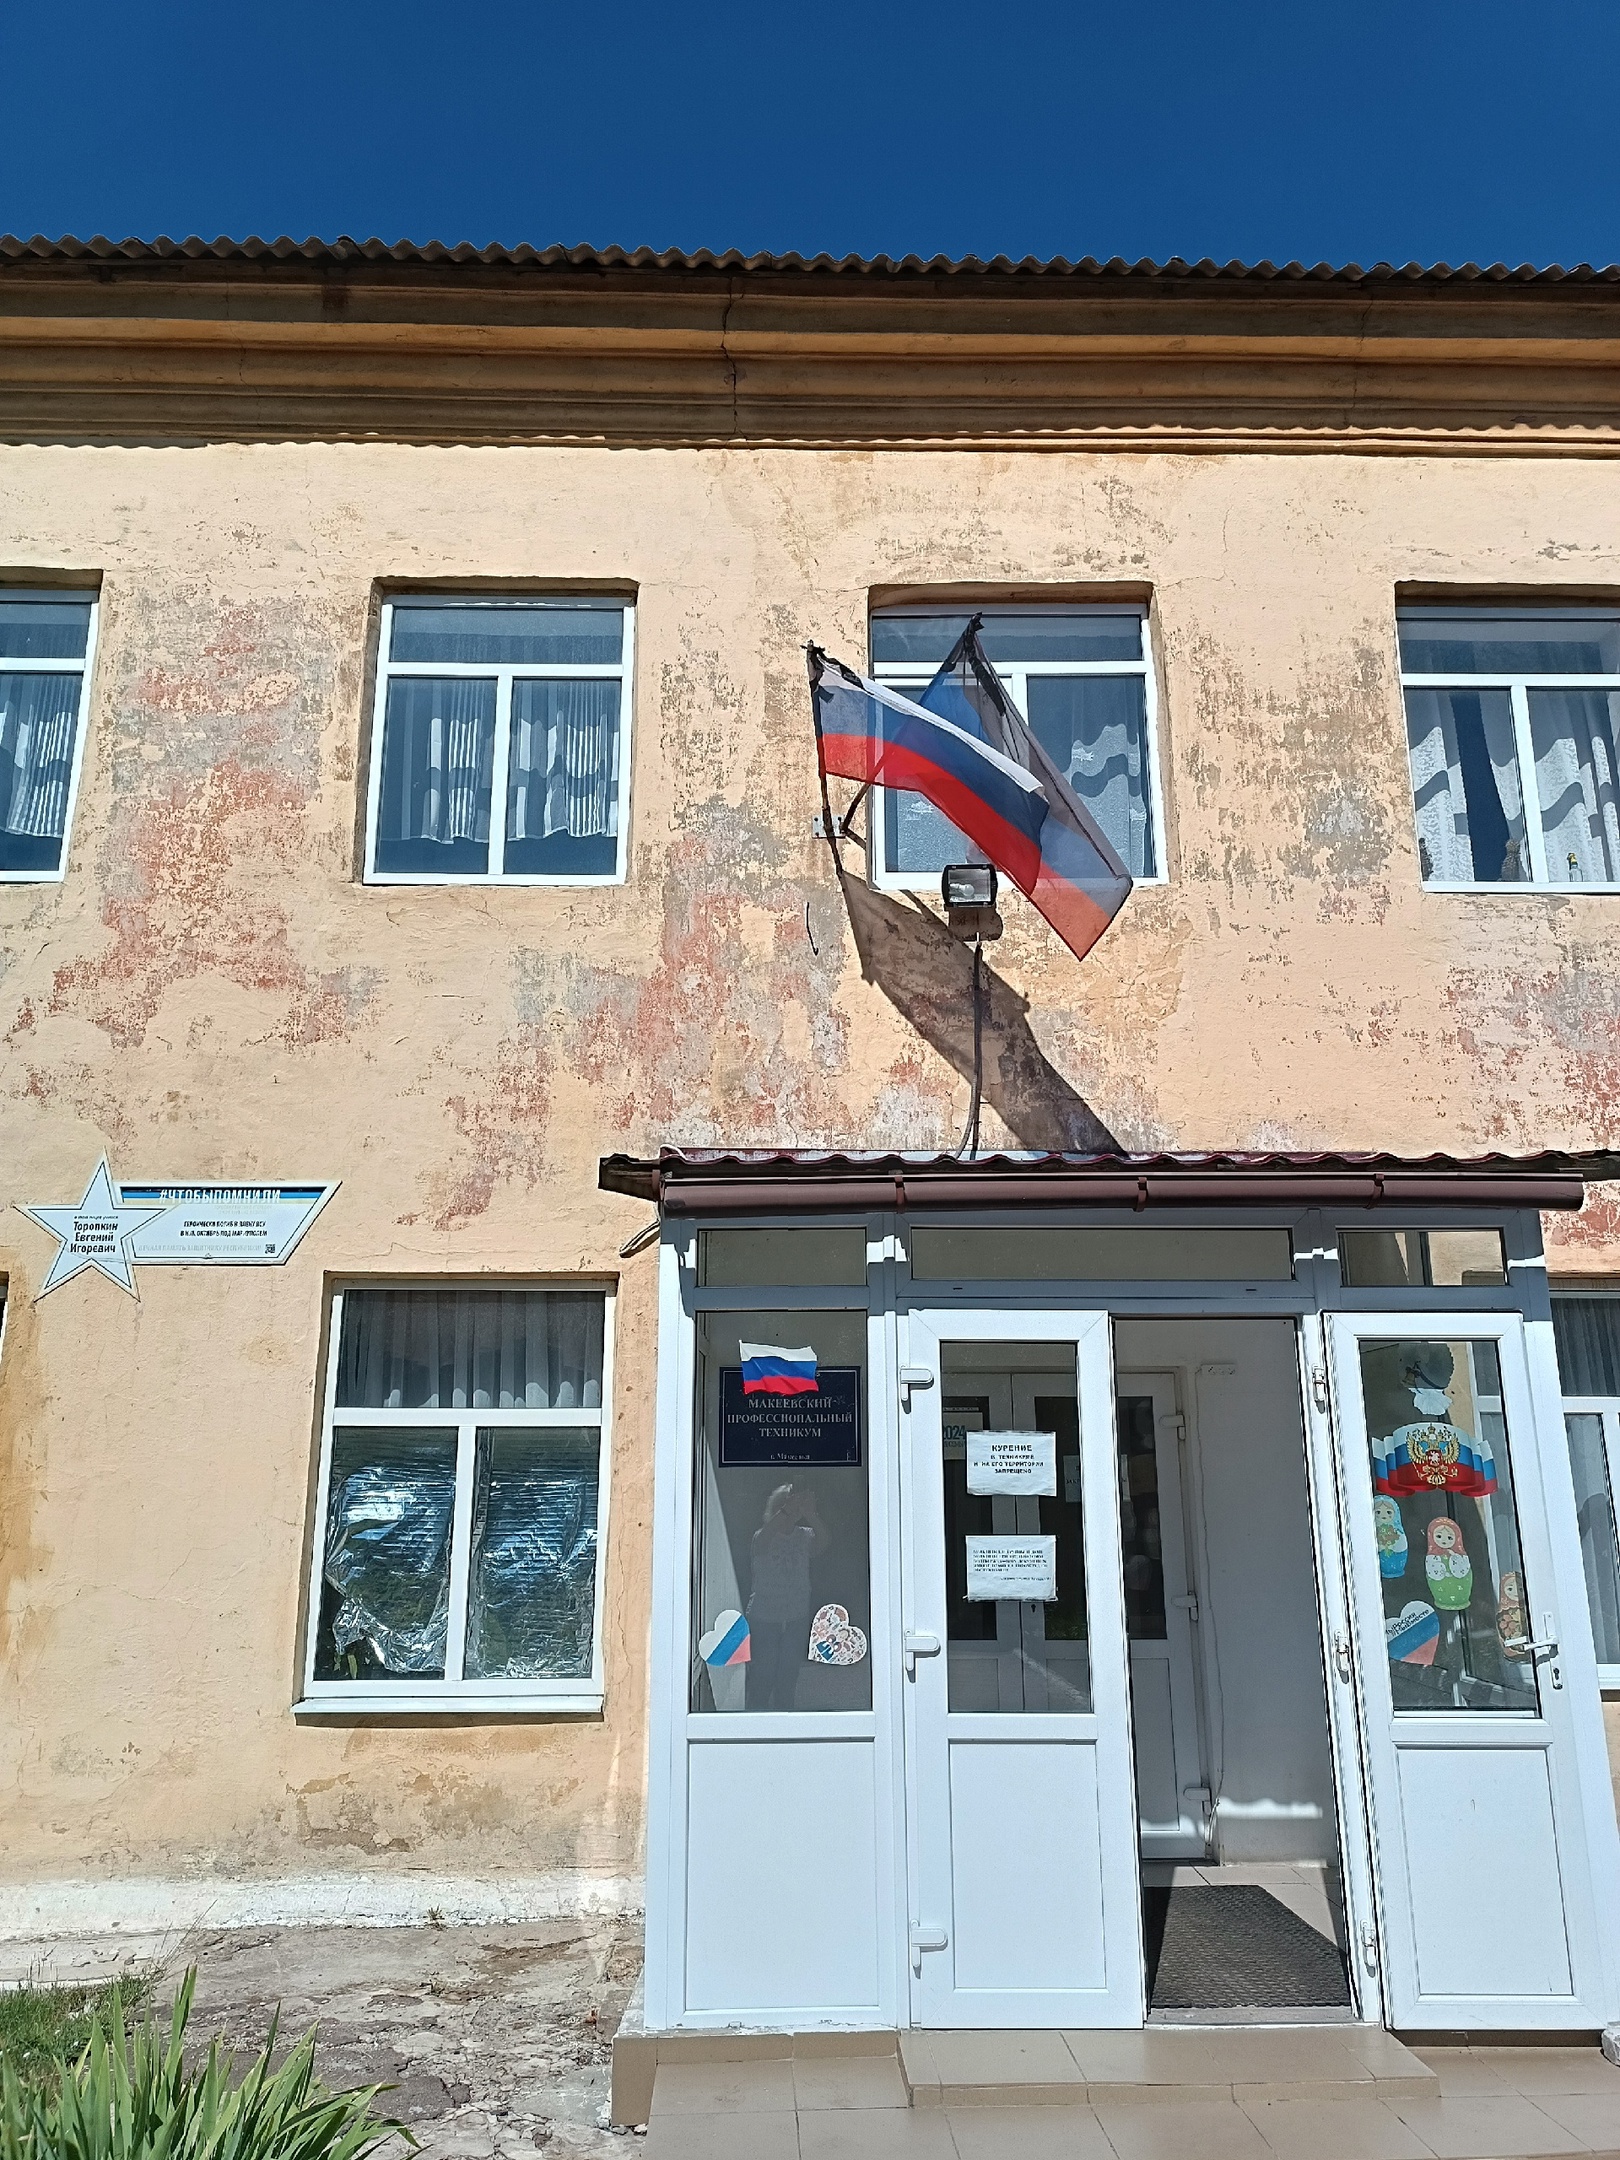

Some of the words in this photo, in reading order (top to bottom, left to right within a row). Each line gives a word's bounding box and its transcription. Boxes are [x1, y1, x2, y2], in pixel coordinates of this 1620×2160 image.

[159, 1189, 281, 1204] #ЧТОБЫПОМНИЛИ
[73, 1221, 118, 1232] Торопкин
[75, 1231, 114, 1242] Евгений
[220, 1230, 231, 1238] ПОД
[70, 1243, 116, 1255] Игоревич
[748, 1396, 832, 1409] МАКЕЕВСКИЙ
[727, 1411, 853, 1424] ПРОФЕССИОНАЛЬНЫЙ
[758, 1428, 821, 1437] ТЕХНИКУМ
[991, 1444, 1033, 1452] КУРЕНИЕ
